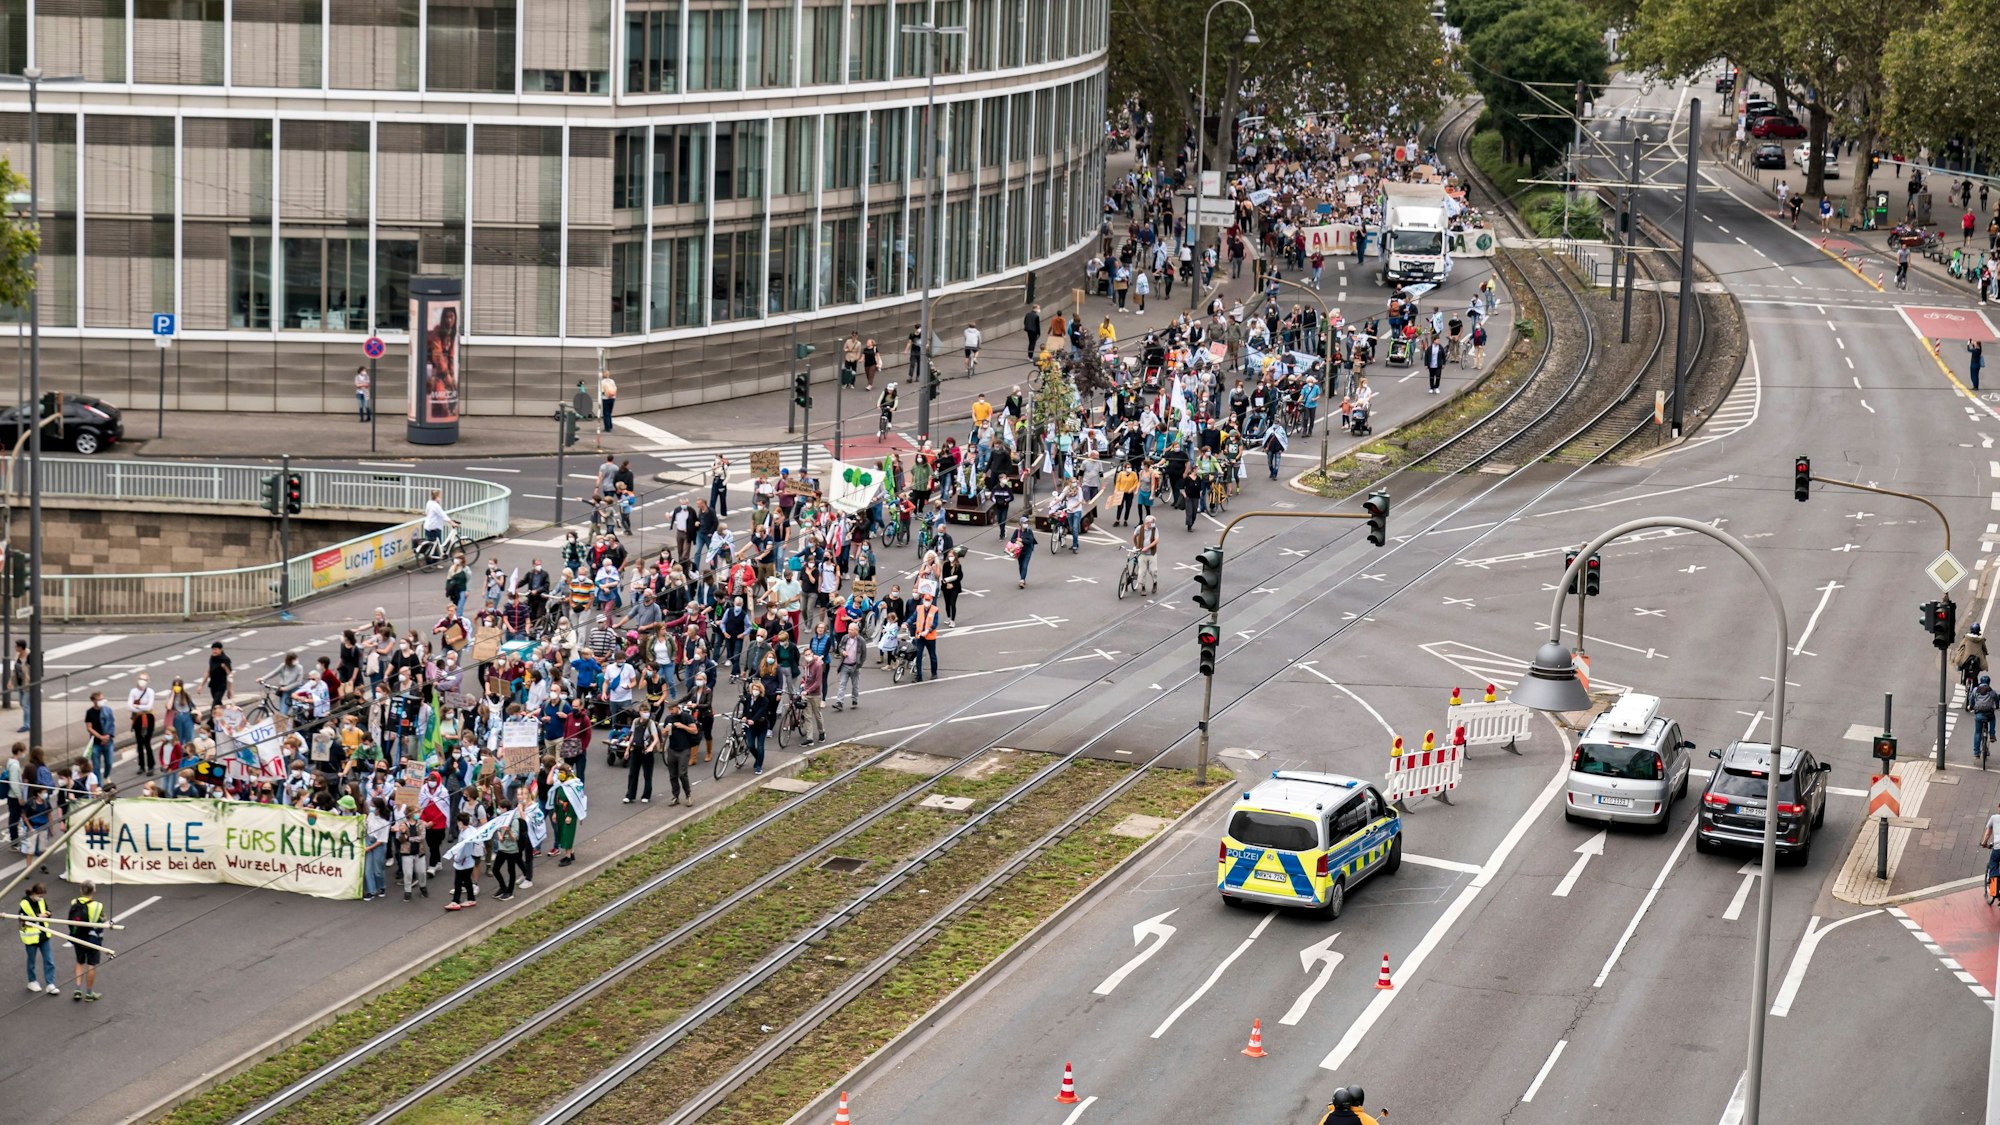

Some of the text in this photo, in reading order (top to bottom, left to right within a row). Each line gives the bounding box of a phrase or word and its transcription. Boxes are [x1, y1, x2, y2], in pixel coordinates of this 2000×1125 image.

[157, 316, 171, 333] P
[84, 818, 355, 860] #ALLE FÜRS KLIMA
[1226, 849, 1259, 860] POLIZEI
[87, 854, 342, 882] Die Krise bei den Wurzeln packen
